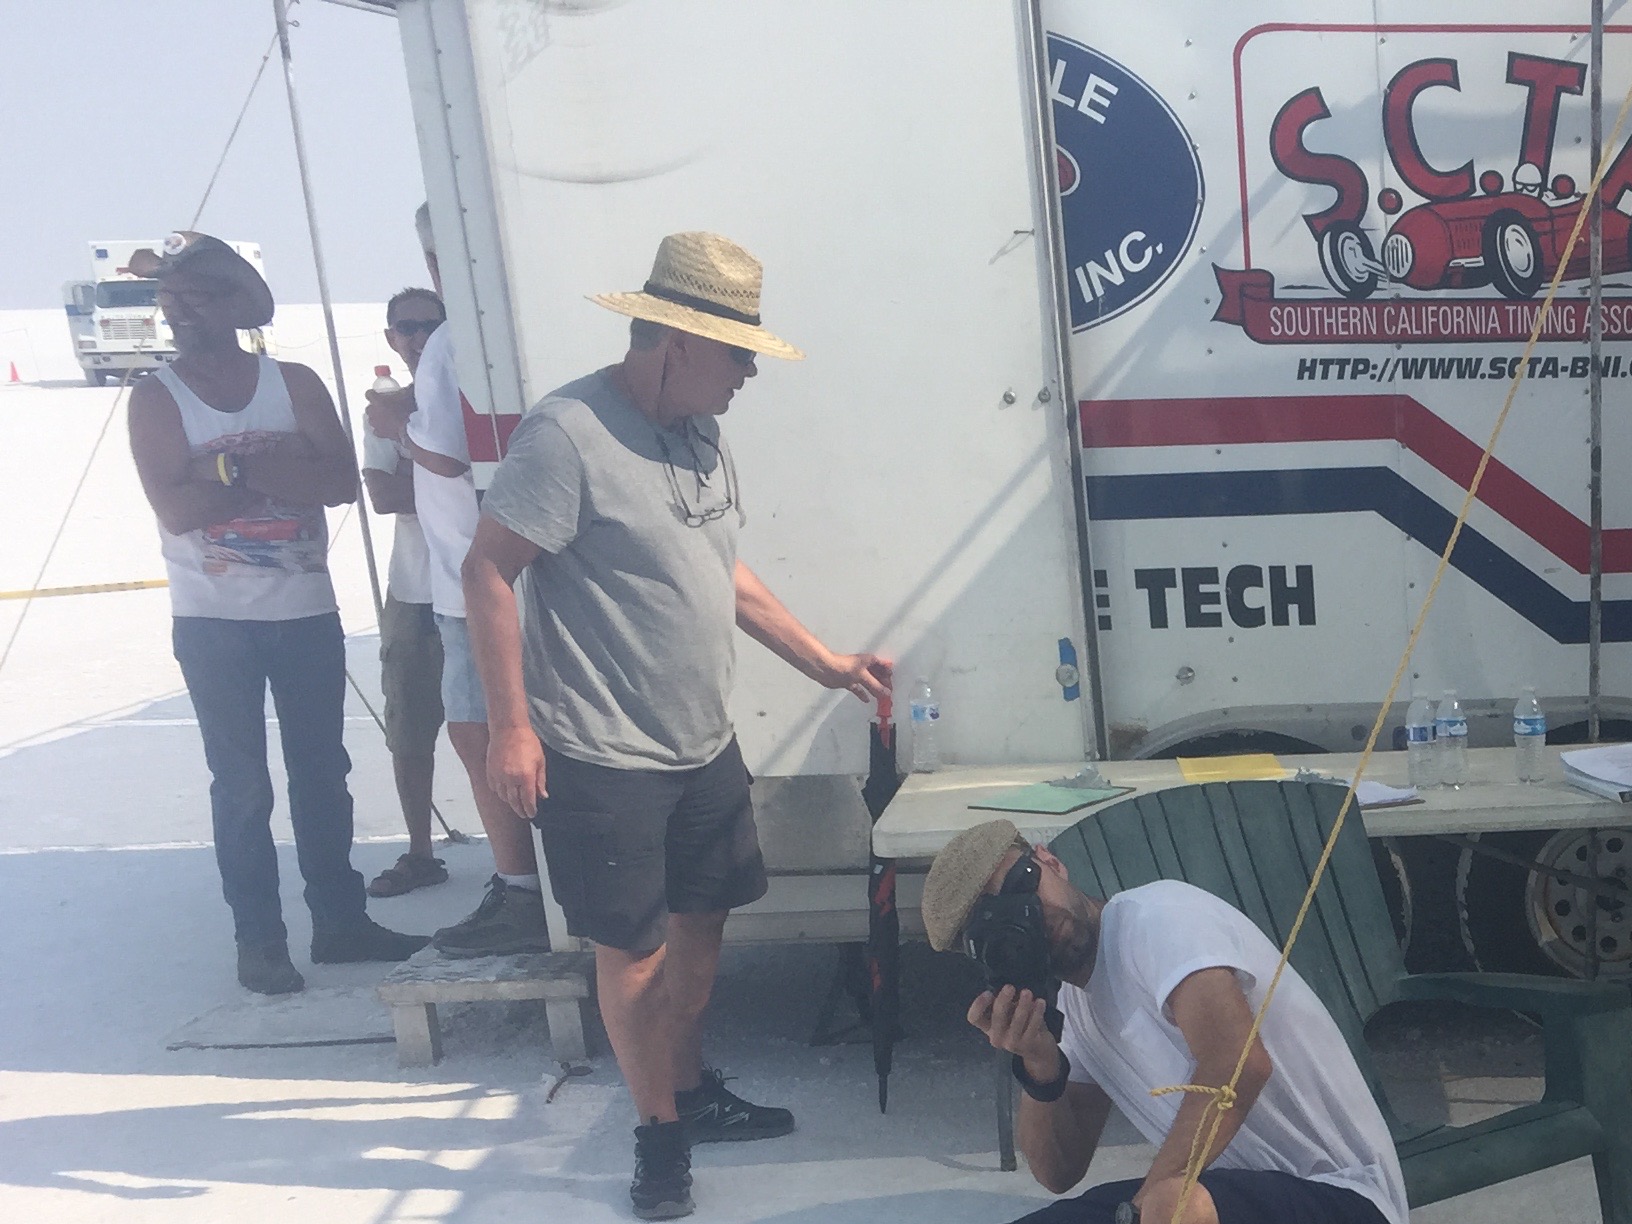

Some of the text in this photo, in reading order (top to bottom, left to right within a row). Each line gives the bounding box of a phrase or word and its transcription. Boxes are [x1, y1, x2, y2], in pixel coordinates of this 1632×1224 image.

[1075, 230, 1163, 304] INC.
[1270, 306, 1377, 336] SOUTHERN
[1383, 305, 1501, 335] CALIFORNIA
[1505, 304, 1576, 334] TIMING
[1134, 564, 1316, 629] TECH
